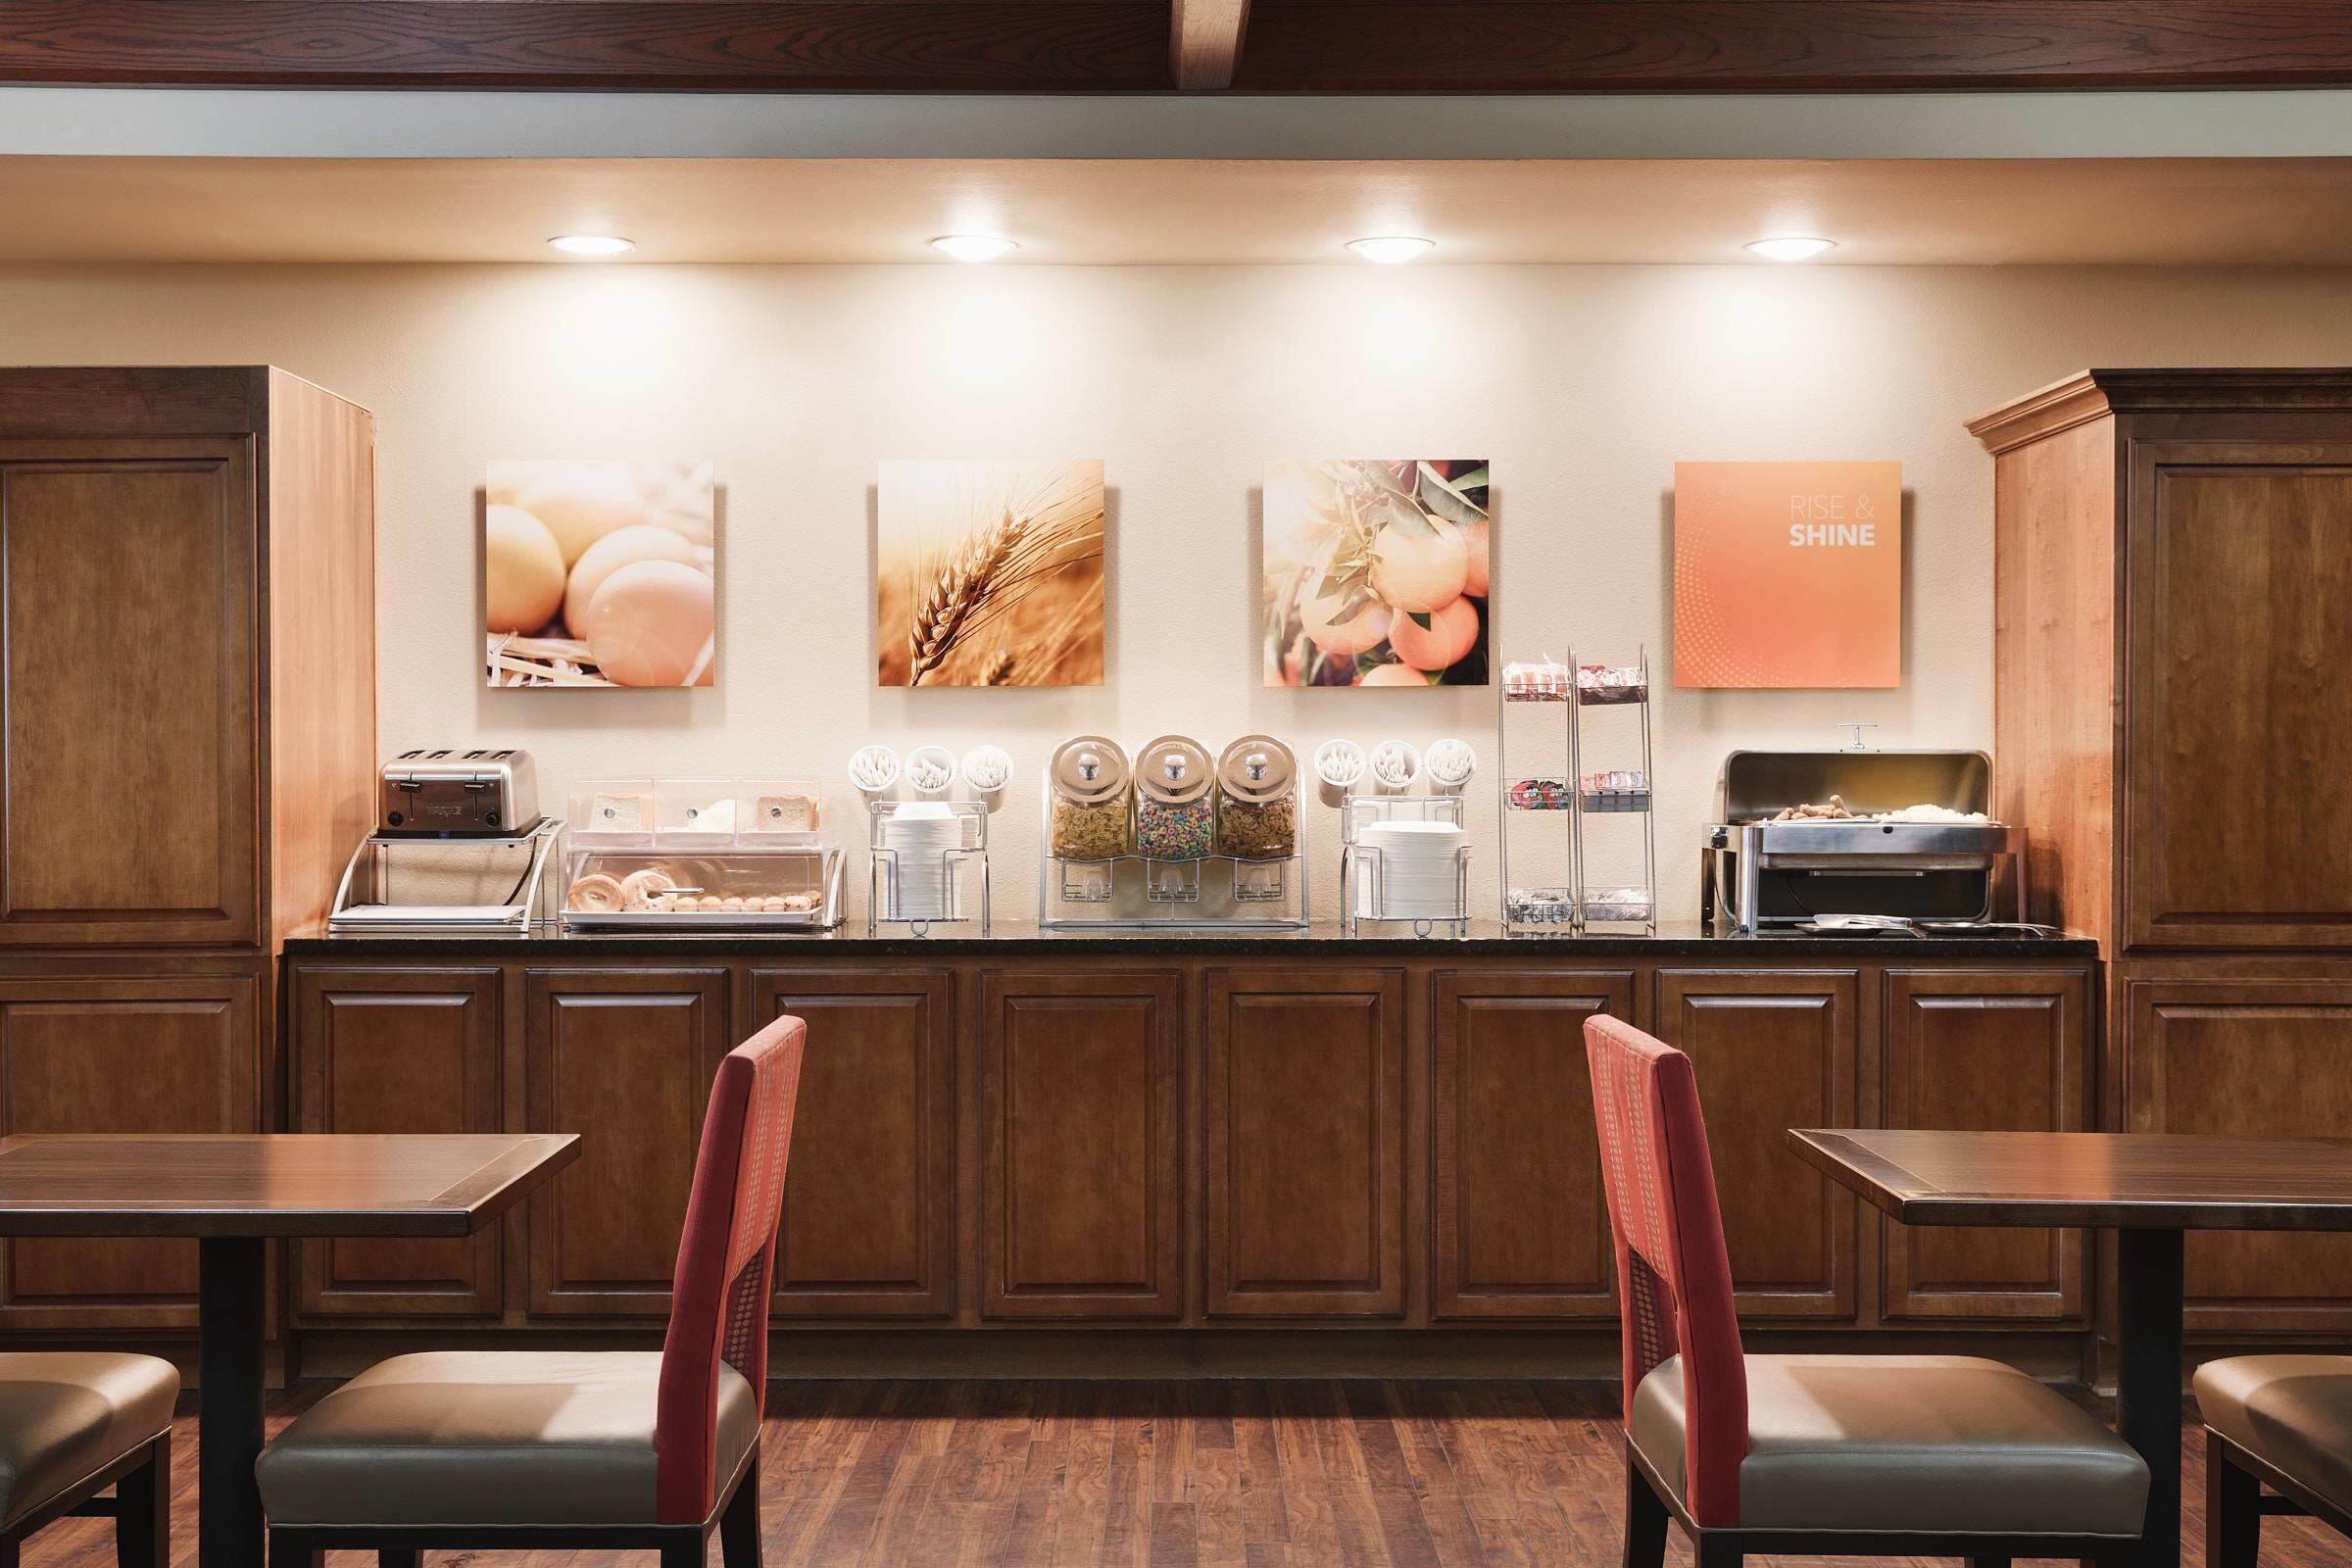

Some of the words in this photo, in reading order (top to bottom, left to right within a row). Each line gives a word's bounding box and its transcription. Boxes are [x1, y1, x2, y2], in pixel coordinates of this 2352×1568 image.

[1790, 495, 1844, 519] RISE
[1855, 494, 1875, 519] &
[1789, 524, 1876, 547] SHINE
